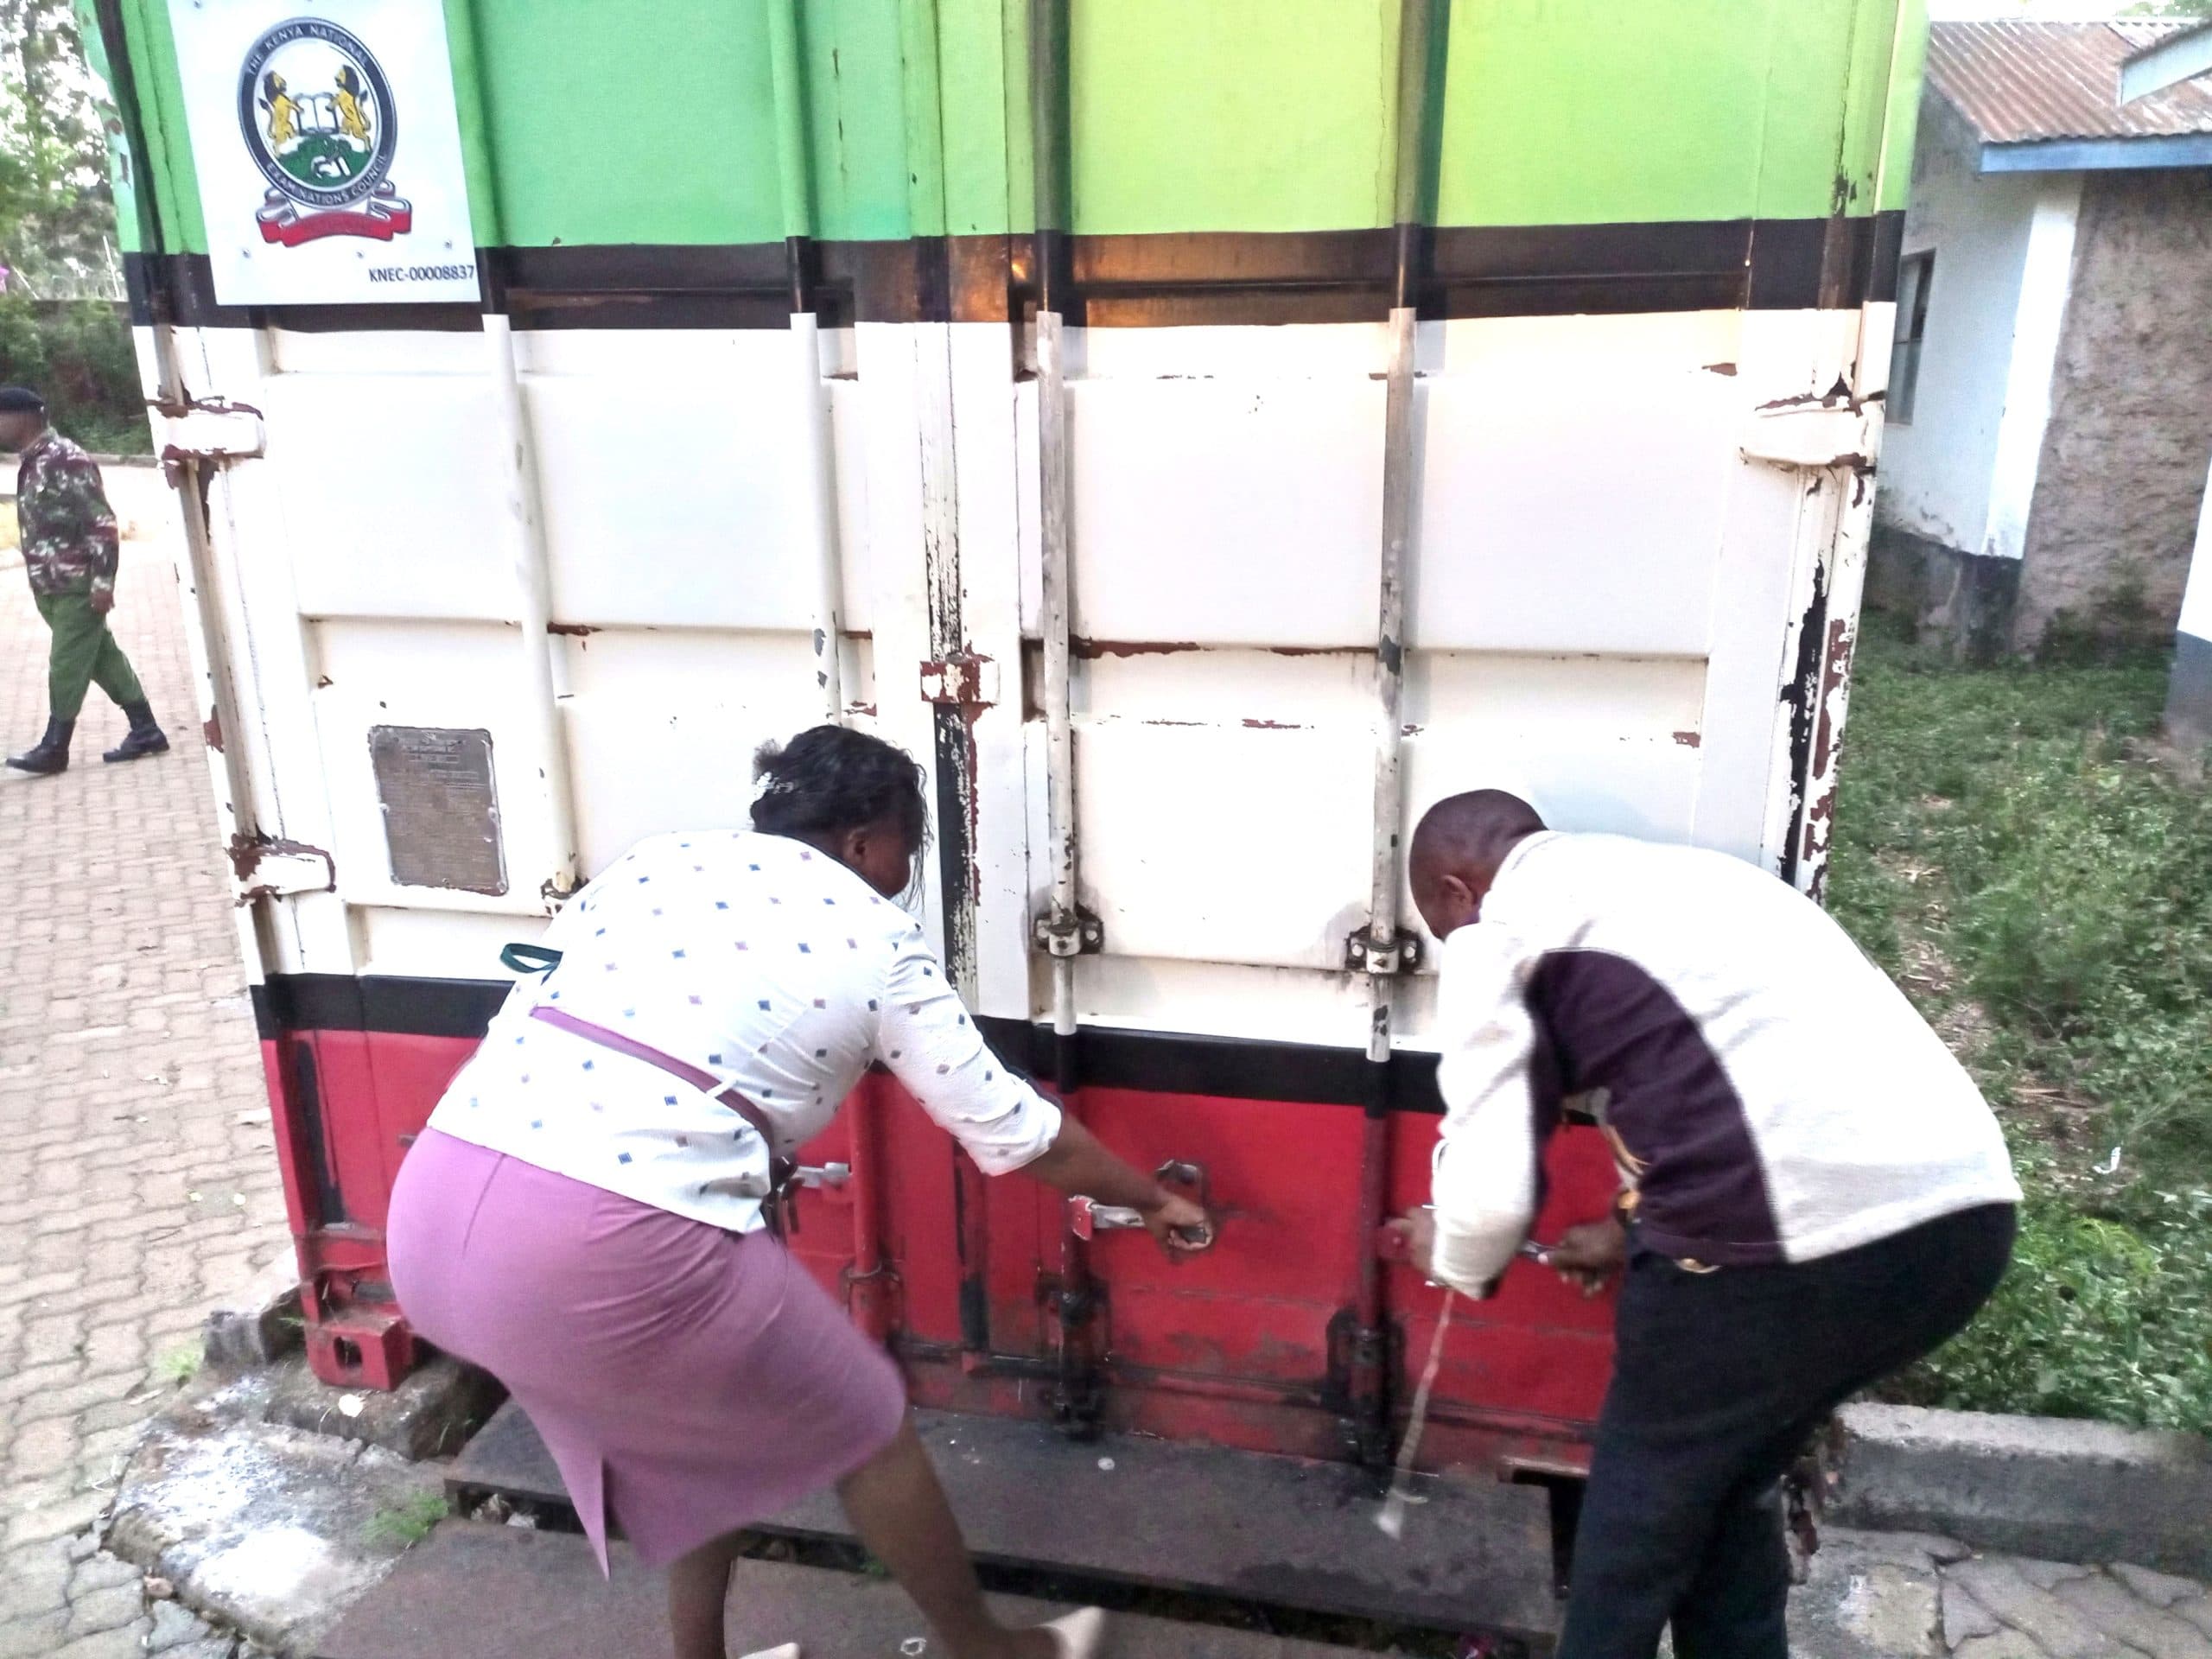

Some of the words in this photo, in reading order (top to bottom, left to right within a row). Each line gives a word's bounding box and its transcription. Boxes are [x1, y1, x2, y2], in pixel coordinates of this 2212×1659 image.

[264, 24, 303, 50] KENYA
[309, 24, 368, 67] NATIONAL
[352, 154, 387, 195] COUNCIL
[368, 264, 474, 283] KNEC-00008837
